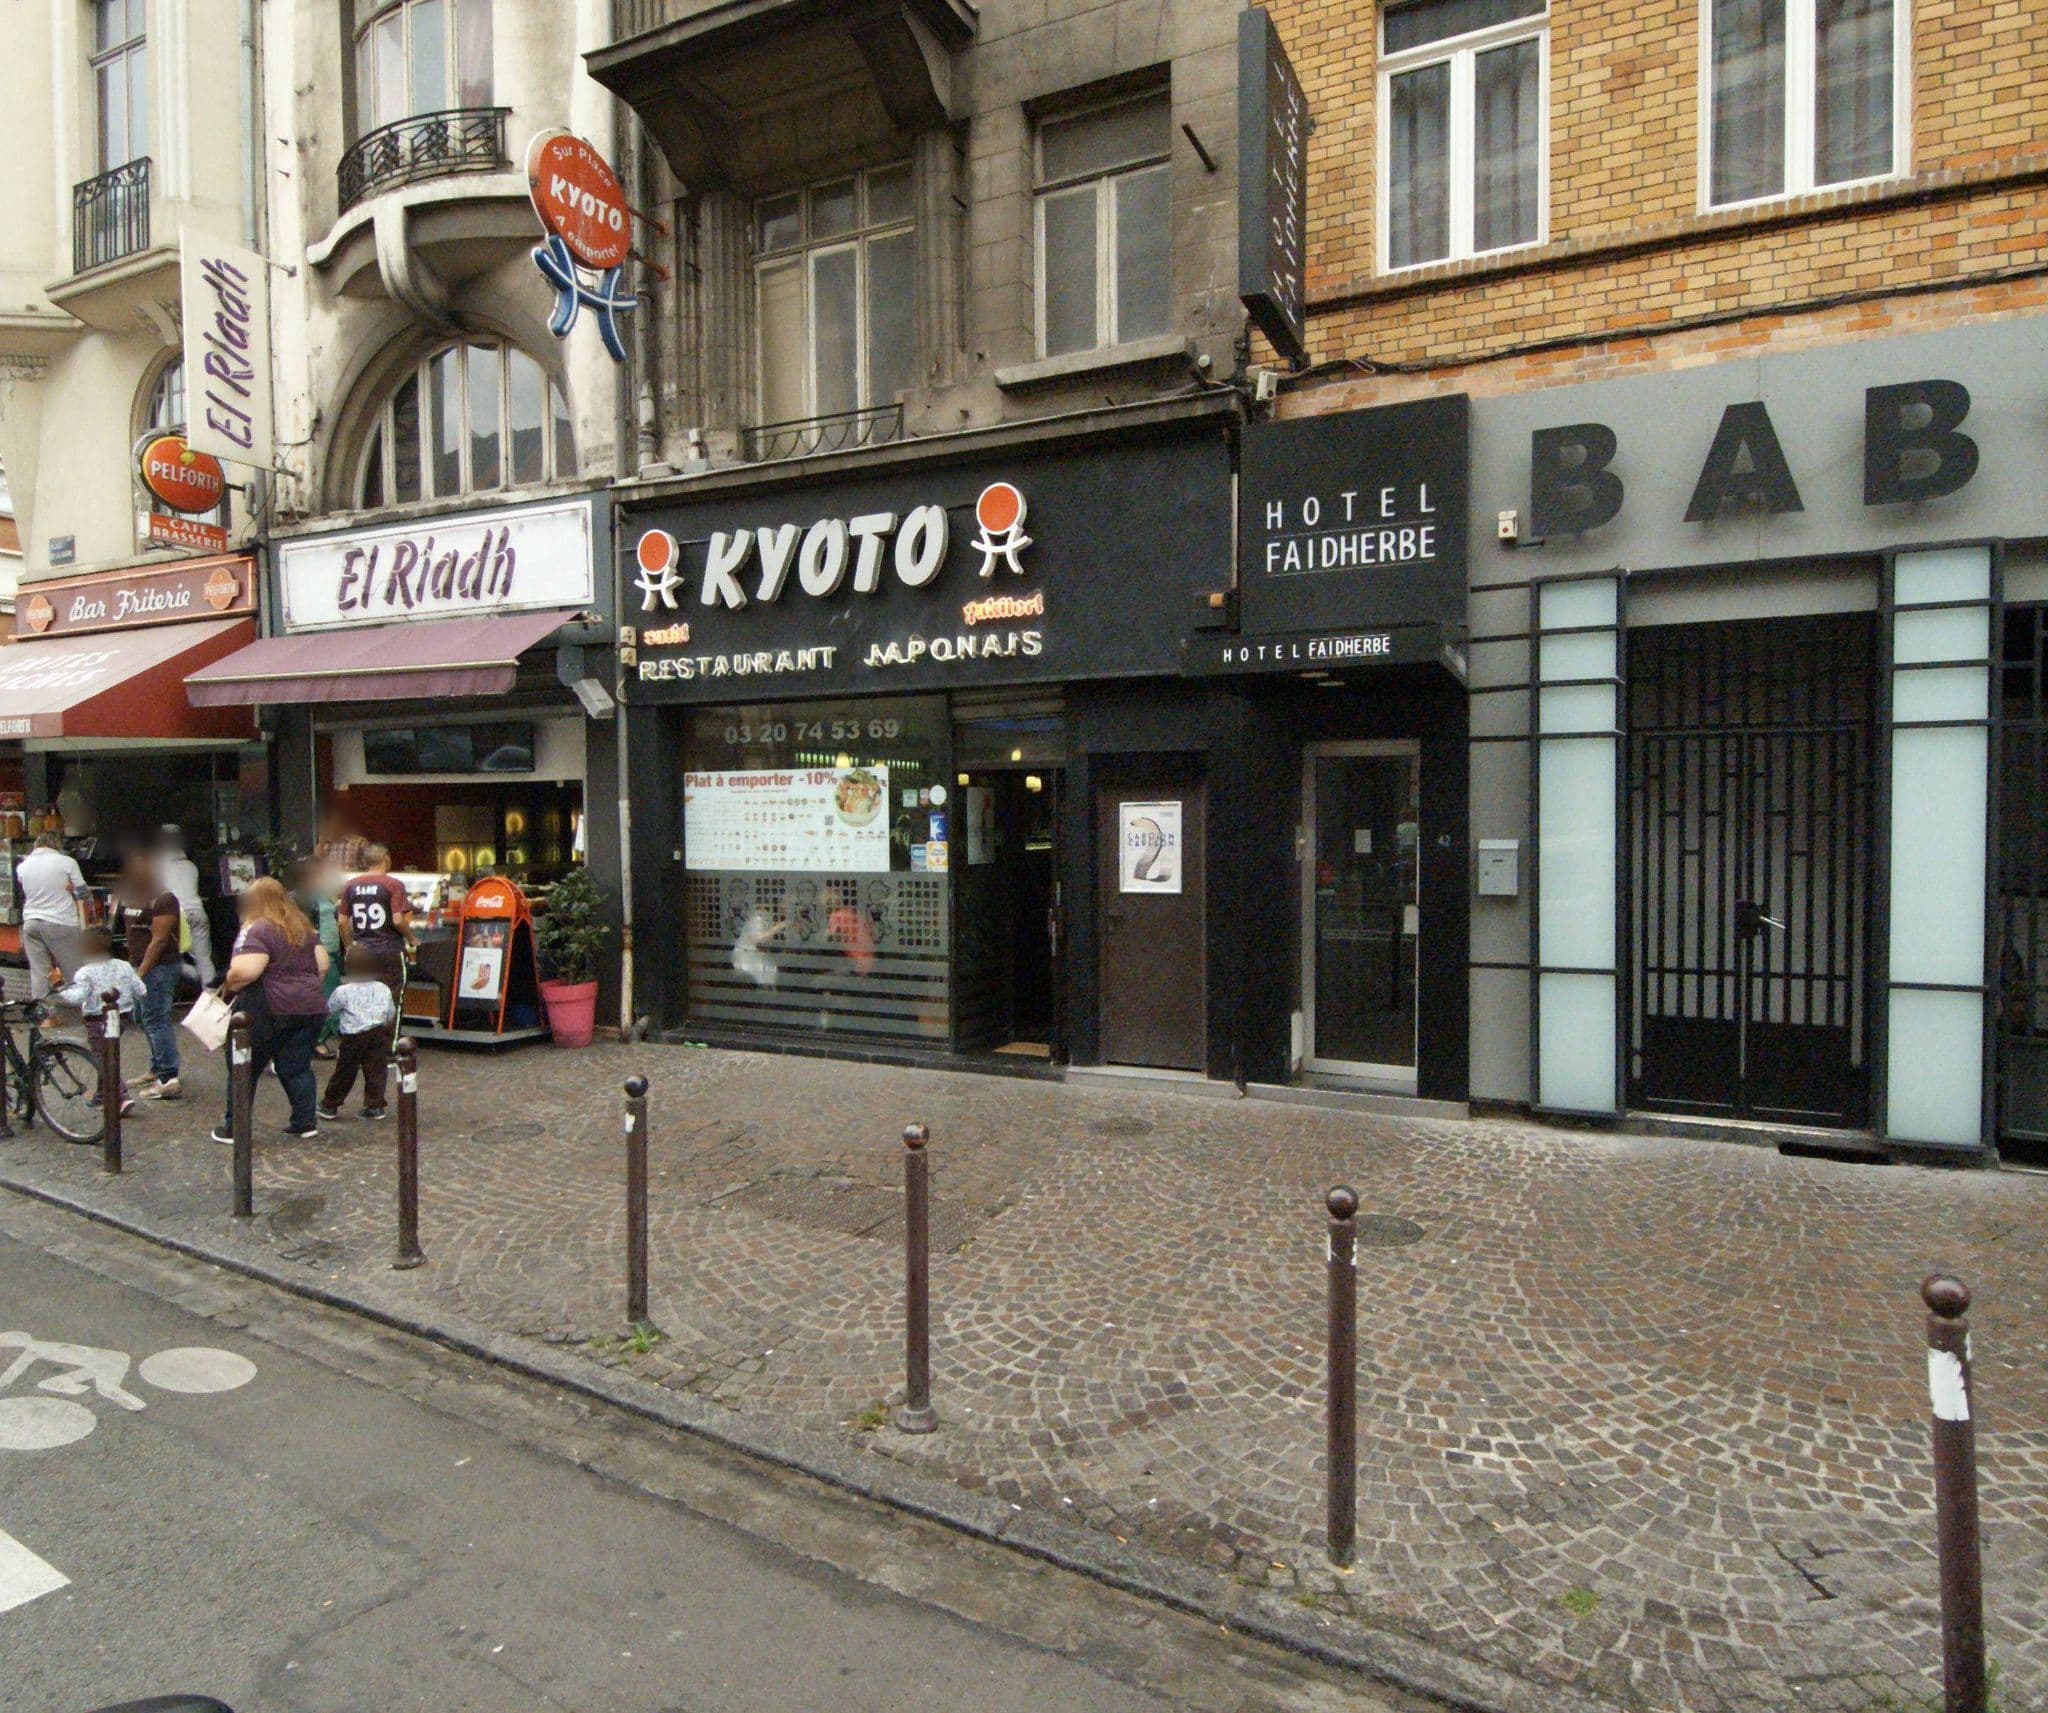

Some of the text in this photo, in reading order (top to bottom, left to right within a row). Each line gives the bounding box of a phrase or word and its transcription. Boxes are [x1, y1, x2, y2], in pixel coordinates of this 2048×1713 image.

[552, 145, 612, 187] Sur Place
[1273, 62, 1284, 302] HOTEL
[550, 173, 623, 232] KYOTO
[200, 258, 254, 449] El Riadh
[151, 460, 220, 493] PELFORTH
[1531, 379, 1979, 538] BAB
[1266, 483, 1436, 530] HOTEL
[152, 526, 223, 549] BRASSERIE
[701, 504, 949, 611] KYOTO
[1266, 526, 1436, 573] FAIDHERBE
[338, 526, 516, 610] El Riadh
[69, 595, 106, 622] Bar
[113, 583, 191, 621] Friterie
[639, 630, 1043, 681] RESTAURANT JAPONAIS
[1223, 636, 1390, 663] HOTEL FAIDHERBE
[724, 718, 899, 744] 03 20 74 53 69
[685, 770, 838, 789] Plat à emporter -10%
[353, 902, 386, 930] 59
